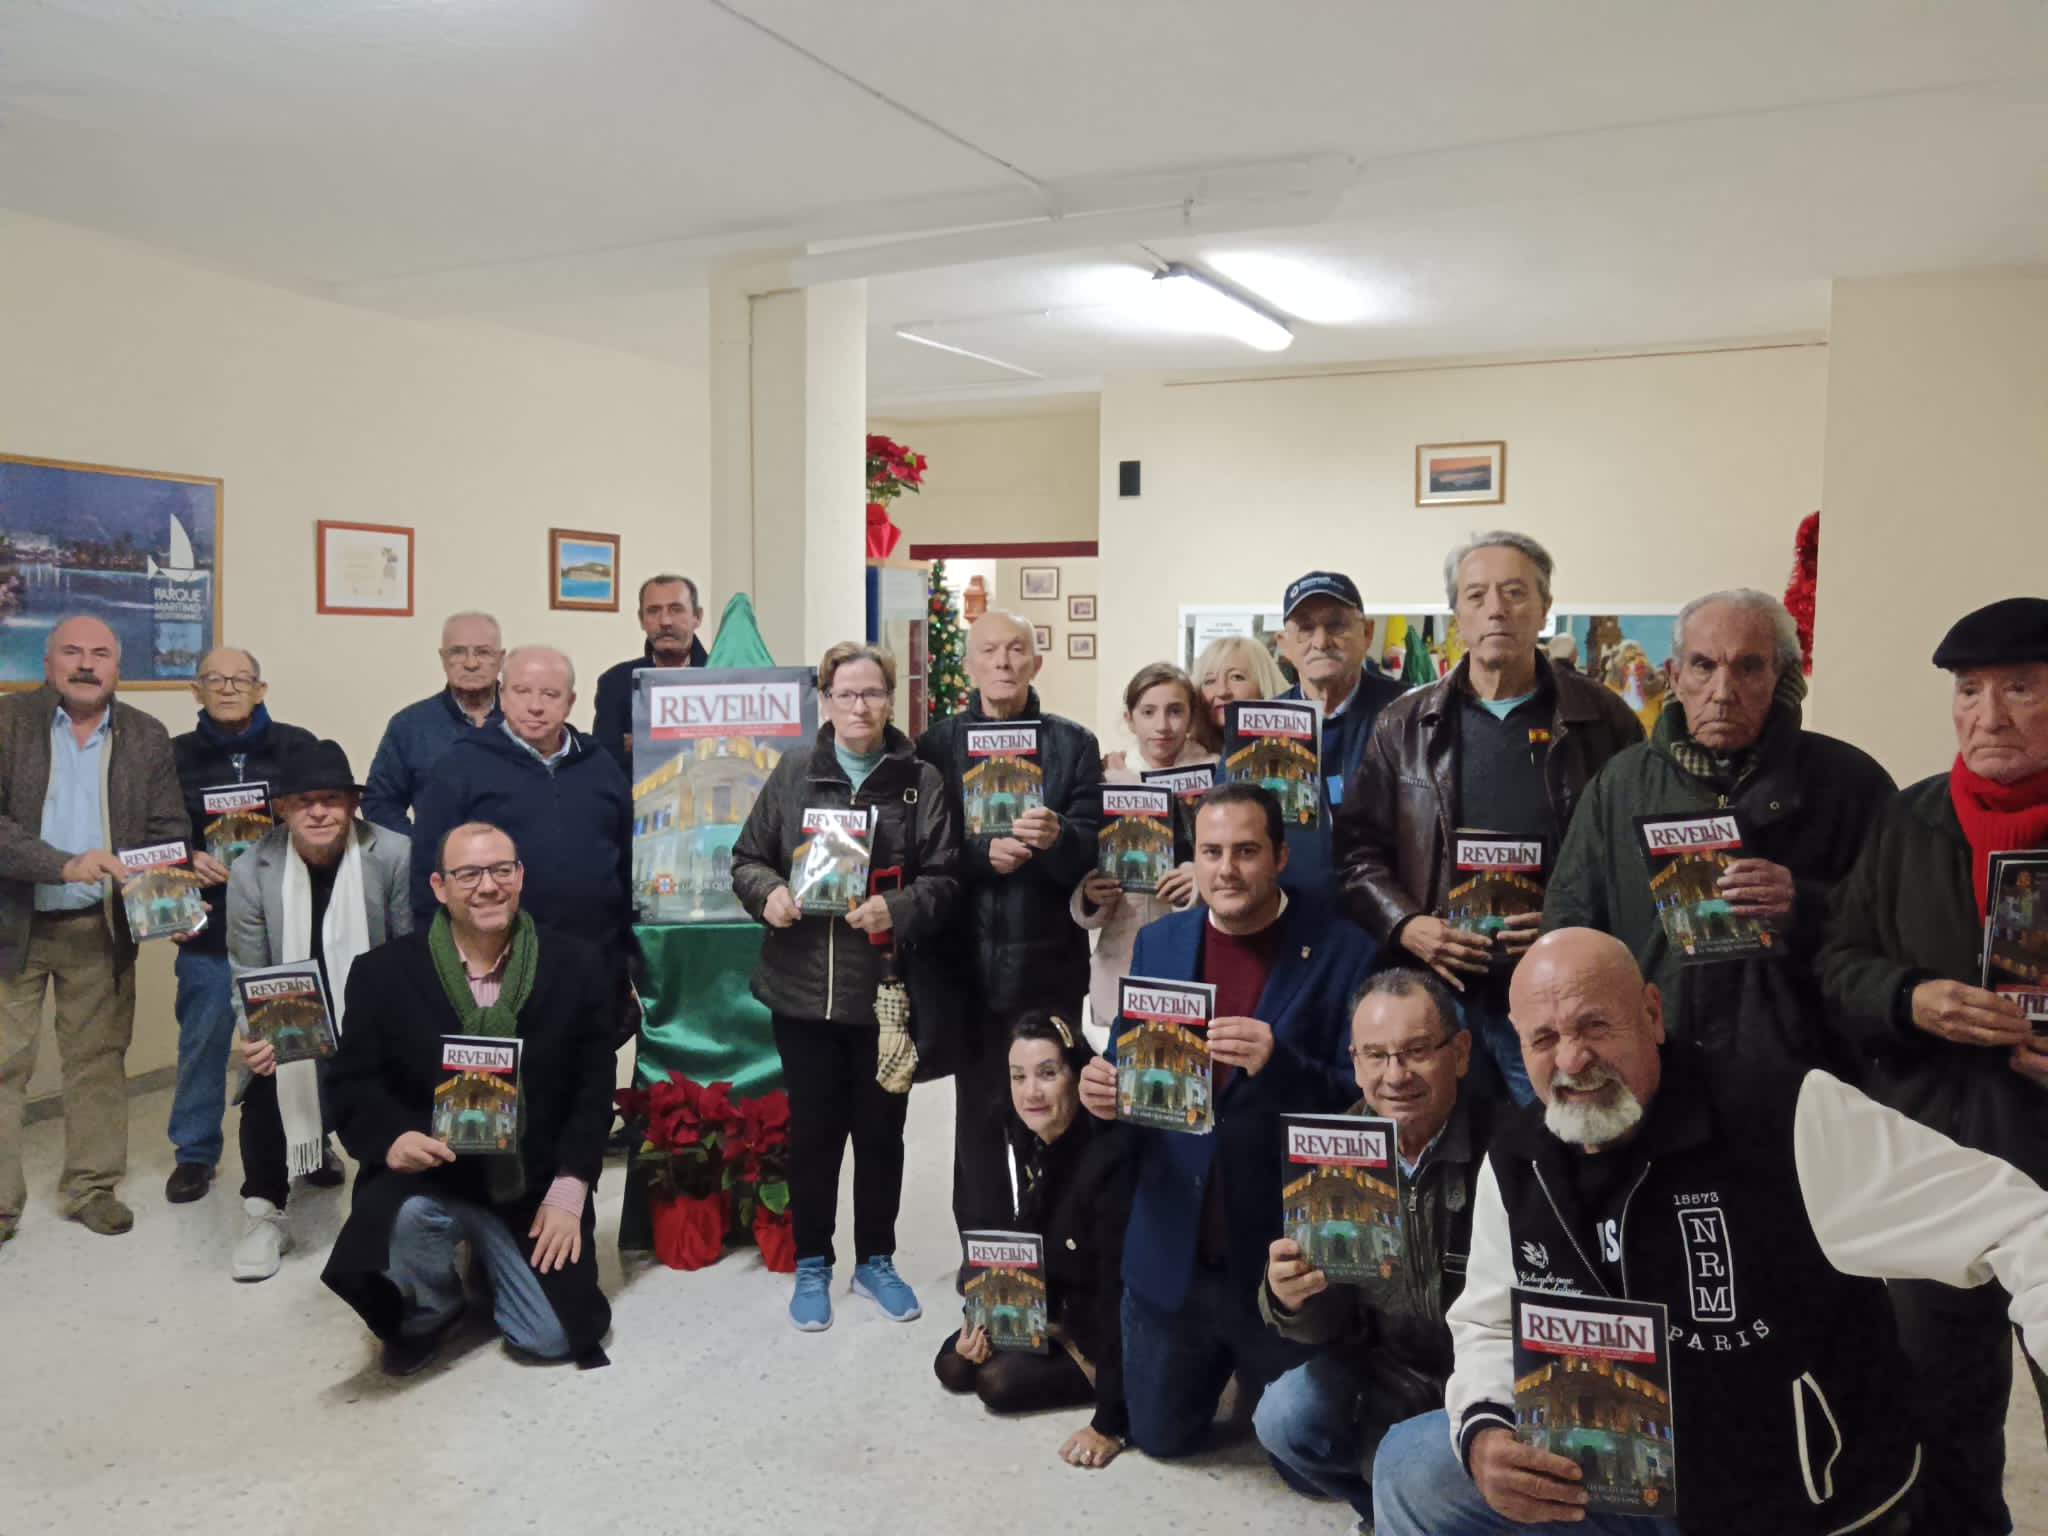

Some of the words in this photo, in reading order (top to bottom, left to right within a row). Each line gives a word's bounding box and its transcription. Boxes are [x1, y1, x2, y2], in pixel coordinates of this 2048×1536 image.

[659, 685, 791, 724] REVELLÍN
[1243, 711, 1307, 732] REVELLÍN
[1107, 793, 1163, 809] REVELLÍN
[1650, 819, 1734, 846] REVELLÍN
[1463, 842, 1537, 864] REVELLÍN
[1128, 993, 1200, 1016] REVELLÍN
[447, 1047, 509, 1066] REVELLÍN
[1294, 1131, 1380, 1158] REVELLÍN
[1528, 1316, 1646, 1350] REVELLÍN
[1668, 1319, 1769, 1351] PARIS
